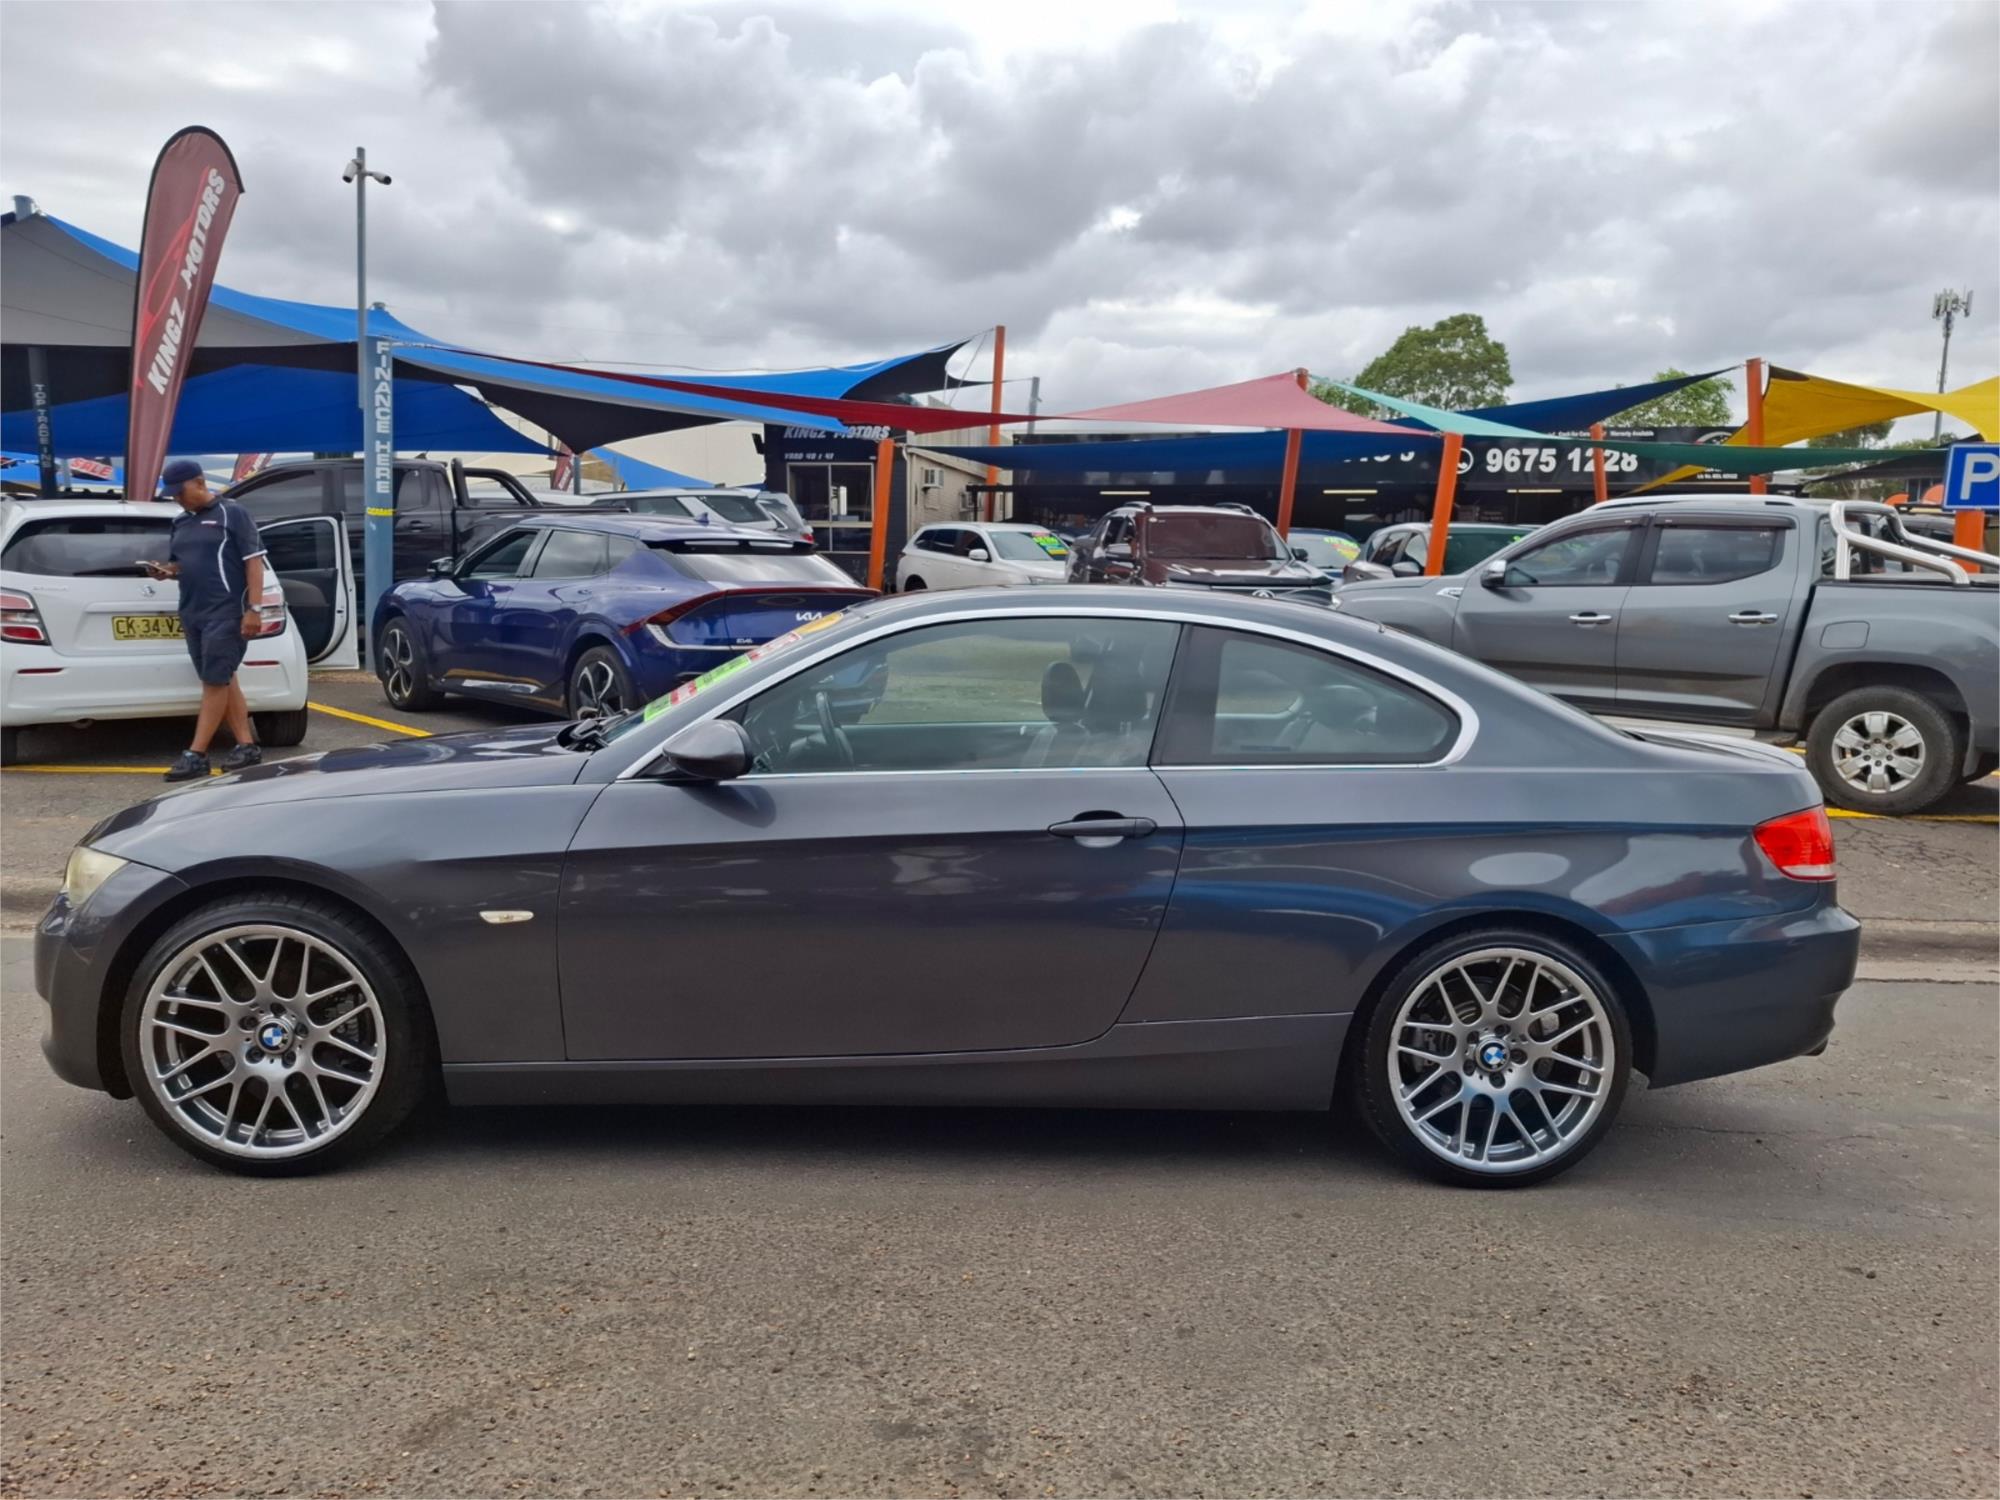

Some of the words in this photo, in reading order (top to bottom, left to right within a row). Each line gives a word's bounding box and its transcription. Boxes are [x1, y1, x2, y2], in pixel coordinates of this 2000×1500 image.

[148, 297, 186, 395] KINGZ
[180, 168, 225, 291] MOTORS
[34, 384, 47, 406] TOP
[374, 341, 392, 434] FINANCE
[37, 409, 49, 445] TRADE
[784, 426, 826, 438] KINGZ
[70, 459, 113, 477] SALE
[374, 440, 392, 493] HERE
[1486, 448, 1556, 473] 9675
[1960, 453, 2000, 500] P
[796, 612, 822, 621] KIA
